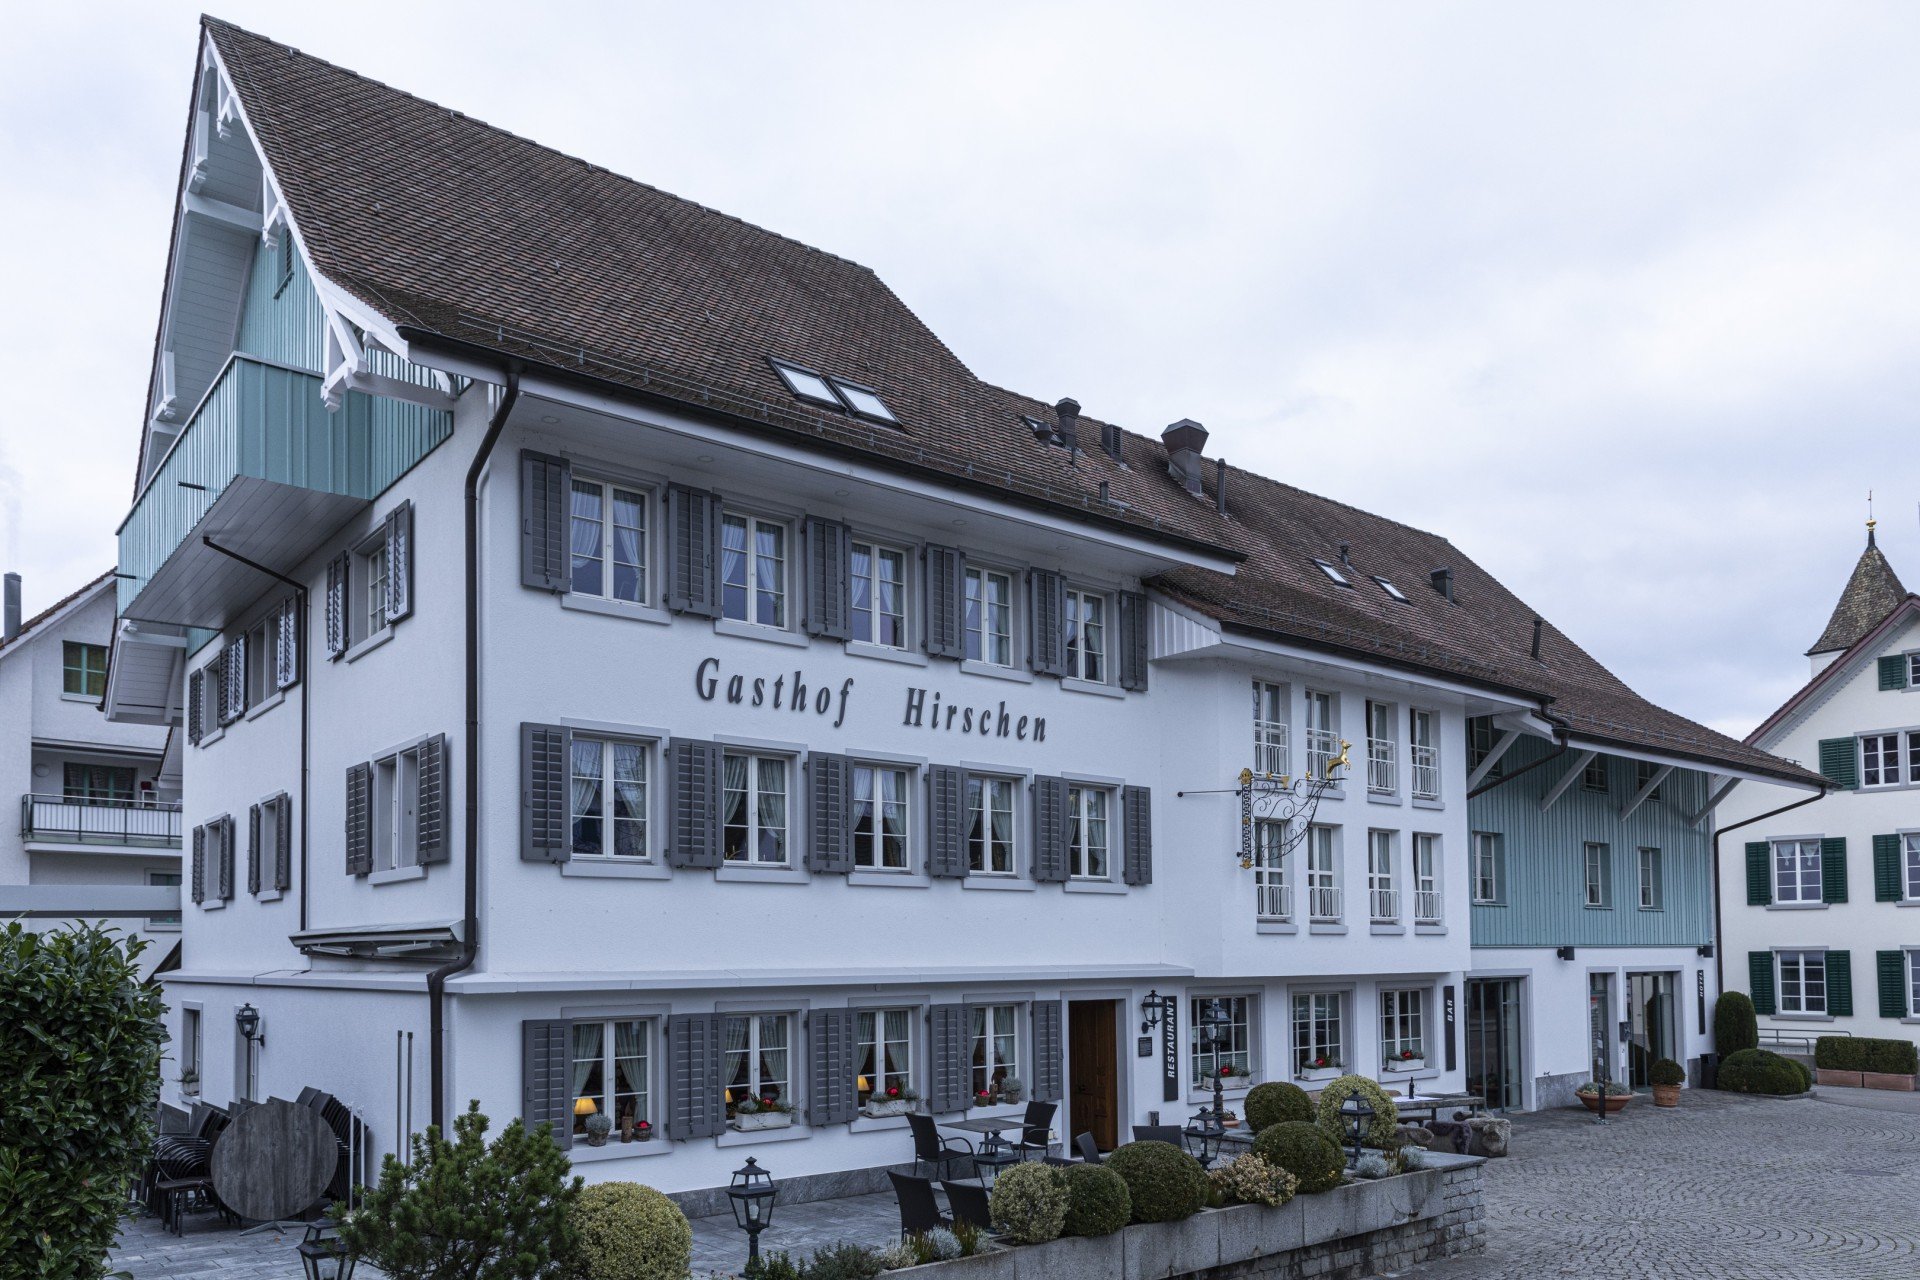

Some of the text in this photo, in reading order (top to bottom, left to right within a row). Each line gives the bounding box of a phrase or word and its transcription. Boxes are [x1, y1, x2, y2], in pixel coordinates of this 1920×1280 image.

[695, 657, 1047, 743] Gasthof Hirschen
[1167, 999, 1175, 1078] RESTAURANT
